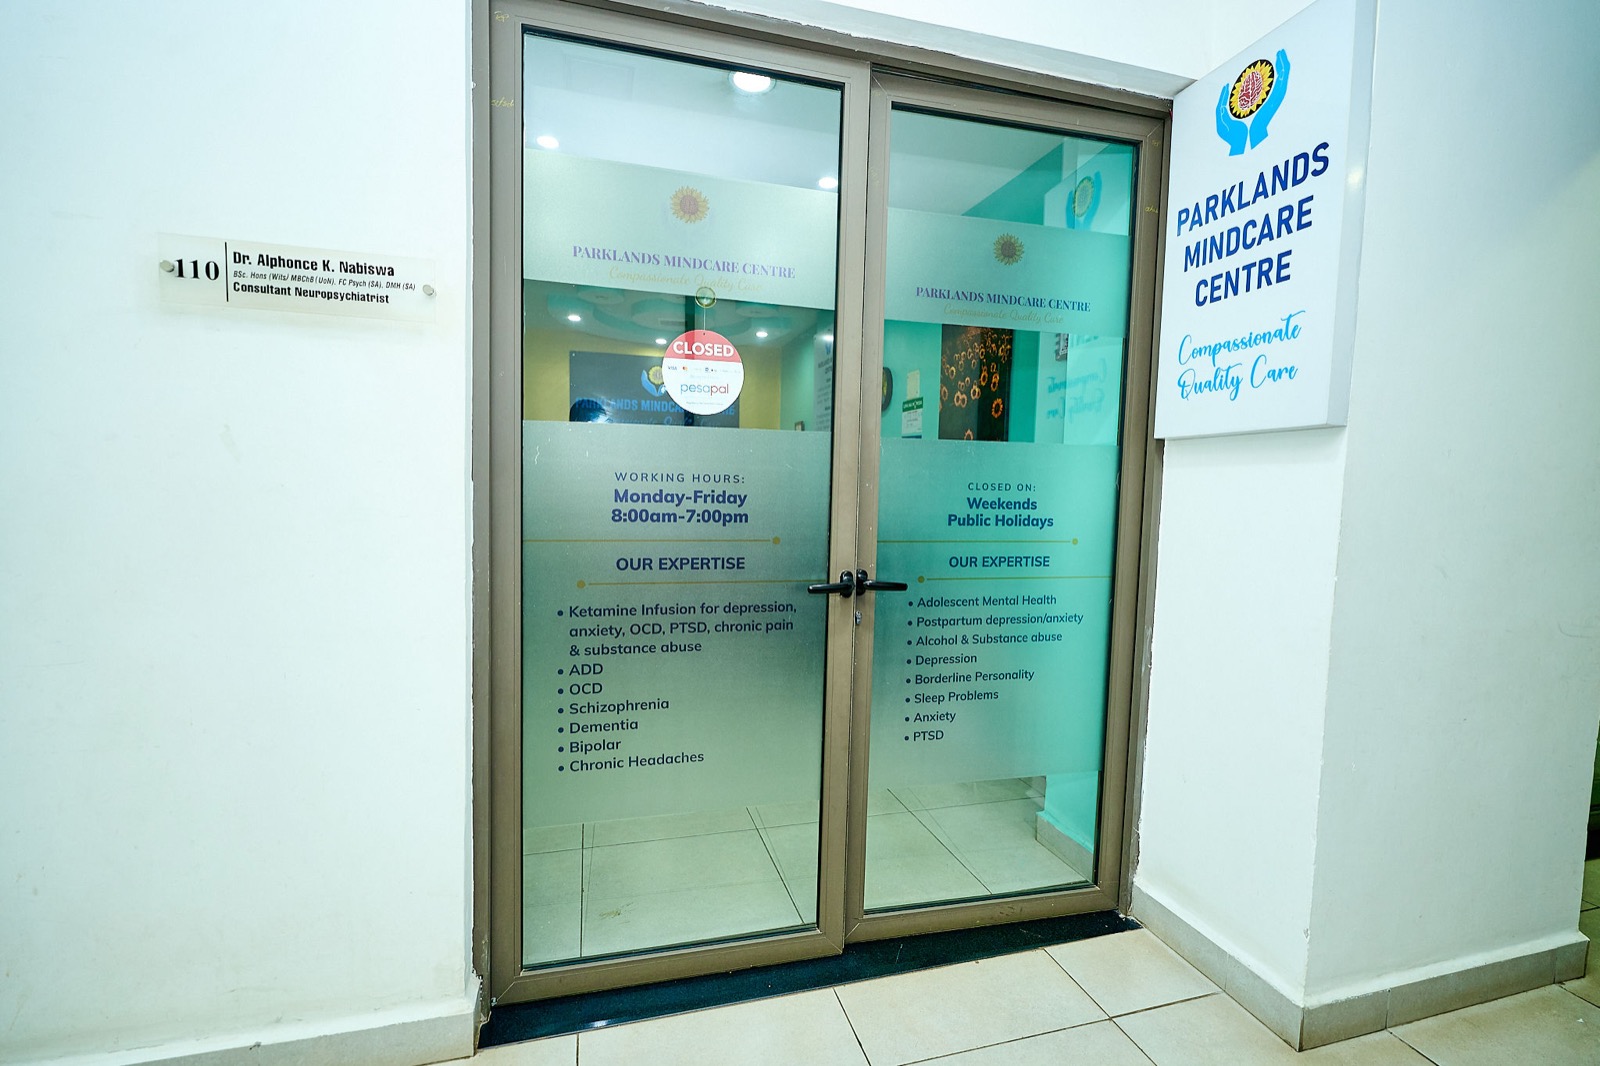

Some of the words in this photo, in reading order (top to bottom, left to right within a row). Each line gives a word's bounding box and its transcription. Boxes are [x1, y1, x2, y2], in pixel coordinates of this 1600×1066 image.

[1177, 141, 1330, 236] PARKLANDS
[1183, 195, 1314, 272] MINDCARE
[174, 258, 220, 280] 110
[233, 251, 252, 265] Dr.
[257, 254, 318, 272] Alphonce
[322, 259, 334, 272] K.
[340, 260, 395, 277] Nabiswa
[573, 245, 660, 266] PARKLANDS
[664, 255, 739, 273] MINDCARE
[743, 262, 796, 279] CENTRE
[250, 272, 267, 280] Hons
[338, 278, 347, 286] FC
[348, 280, 366, 288] Psych
[402, 283, 416, 291] (SA)
[608, 266, 689, 286] Compassionate
[695, 274, 734, 291] Quality
[1195, 249, 1292, 308] CENTRE
[233, 282, 292, 296] Consultant
[294, 286, 390, 304] Neuropsychiatrist
[916, 286, 984, 302] PARKLANDS
[987, 293, 1047, 308] MINDCARE
[1048, 299, 1091, 312] CENTRE
[943, 304, 1006, 320] Compassionate
[1010, 309, 1041, 324] Quality
[1178, 310, 1306, 367] Compassionate
[672, 341, 734, 357] CLOSED
[1177, 362, 1244, 402] Quality
[1250, 354, 1299, 389] Care
[680, 384, 729, 396] pesapal
[641, 400, 685, 413] MINDCA
[614, 472, 686, 483] WORKING
[692, 473, 746, 484] HOURS:
[968, 482, 1012, 492] CLOSED
[1016, 483, 1036, 492] ON:
[614, 488, 748, 508] Monday-Friday
[966, 497, 1038, 510] Weekends
[611, 508, 749, 528] 8:00am-7:00pm
[948, 514, 991, 527] Public
[994, 514, 1054, 530] Holidays
[616, 558, 653, 570] OUR
[658, 557, 746, 570] EXPERTISE
[949, 556, 978, 568] OUR
[982, 556, 1050, 568] EXPERTISE
[569, 604, 638, 618] Ketamine
[641, 603, 696, 616] Infusion
[700, 602, 720, 614] for
[723, 600, 797, 617] depression,
[917, 596, 980, 608] Adolescent
[982, 596, 1019, 606] Mental
[1022, 594, 1056, 606] Health
[916, 616, 982, 628] Postpartum
[985, 612, 1084, 627] depression/anxiety
[569, 623, 626, 640] anxiety,
[630, 623, 666, 636] OCD,
[670, 621, 711, 635] PTSD,
[714, 620, 762, 633] chronic
[765, 620, 794, 634] pain
[916, 634, 958, 646] Alcohol
[960, 635, 970, 645] &
[972, 633, 1028, 644] Substance
[1031, 632, 1063, 642] abuse
[570, 644, 580, 656] &
[584, 642, 656, 656] substance
[660, 641, 702, 654] abuse
[916, 654, 978, 667] Depression
[569, 664, 604, 676] ADD
[915, 672, 972, 685] Borderline
[975, 669, 1035, 682] Personality
[569, 683, 604, 696] OCD
[914, 692, 945, 704] Sleep
[948, 690, 999, 702] Problems
[569, 699, 670, 716] Schizophrenia
[914, 710, 956, 723] Anxiety
[570, 720, 639, 734] Dementia
[913, 730, 944, 742] PTSD
[570, 739, 622, 754] Bipolar
[570, 757, 624, 772] Chronic
[628, 752, 704, 768] Headaches
